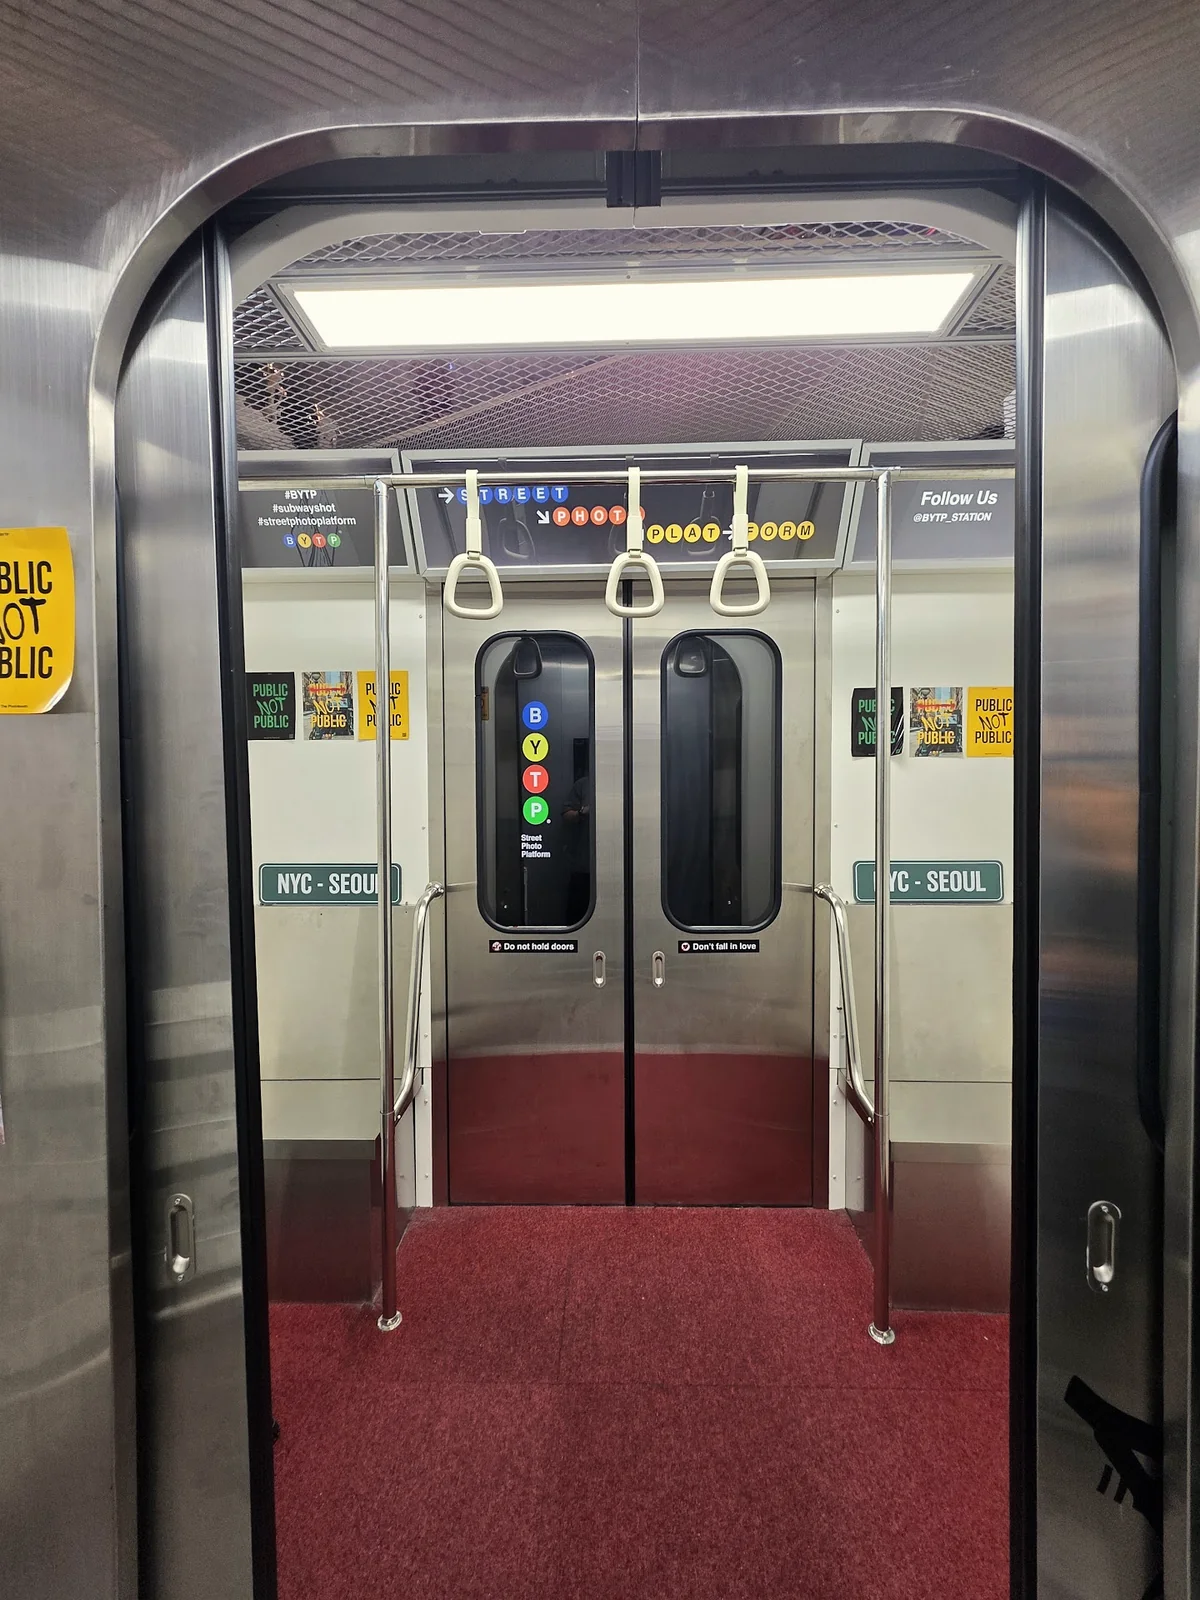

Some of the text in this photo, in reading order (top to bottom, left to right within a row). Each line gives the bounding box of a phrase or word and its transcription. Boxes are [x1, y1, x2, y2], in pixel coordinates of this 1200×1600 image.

[285, 490, 317, 500] #BYTP
[459, 487, 567, 502] STREET
[921, 490, 998, 506] Follow Us
[273, 503, 336, 514] #subwayshot
[258, 516, 357, 527] #streetphotoplatform
[913, 512, 992, 523] @BYTP_STATION
[650, 525, 717, 541] PLAT
[0, 561, 52, 594] BLIC
[0, 597, 47, 644] OT
[0, 646, 53, 679] BLIC
[253, 683, 288, 697] PUBLIC
[366, 682, 401, 695] PUIC
[256, 697, 286, 715] NOT
[313, 696, 342, 714] NOT
[858, 699, 895, 713] PUBC
[975, 698, 1012, 712] PUBLIC
[254, 714, 289, 728] PUBLIC
[311, 714, 347, 728] PUBLIC
[367, 713, 402, 726] PUIC
[921, 713, 952, 731] NOT
[979, 712, 1009, 730] NOT
[858, 731, 896, 745] PUBC
[917, 731, 955, 744] PUBLIC
[975, 730, 1012, 744] PUBLIC
[521, 834, 542, 842] Street
[521, 842, 543, 850] Photo
[521, 850, 551, 858] Platform
[277, 873, 312, 894] NYC
[874, 871, 909, 893] YC
[926, 871, 986, 892] SEOUL
[503, 942, 575, 951] Do not hold doors
[692, 942, 715, 951] Don't
[715, 942, 728, 950] fall
[739, 942, 757, 950] love
